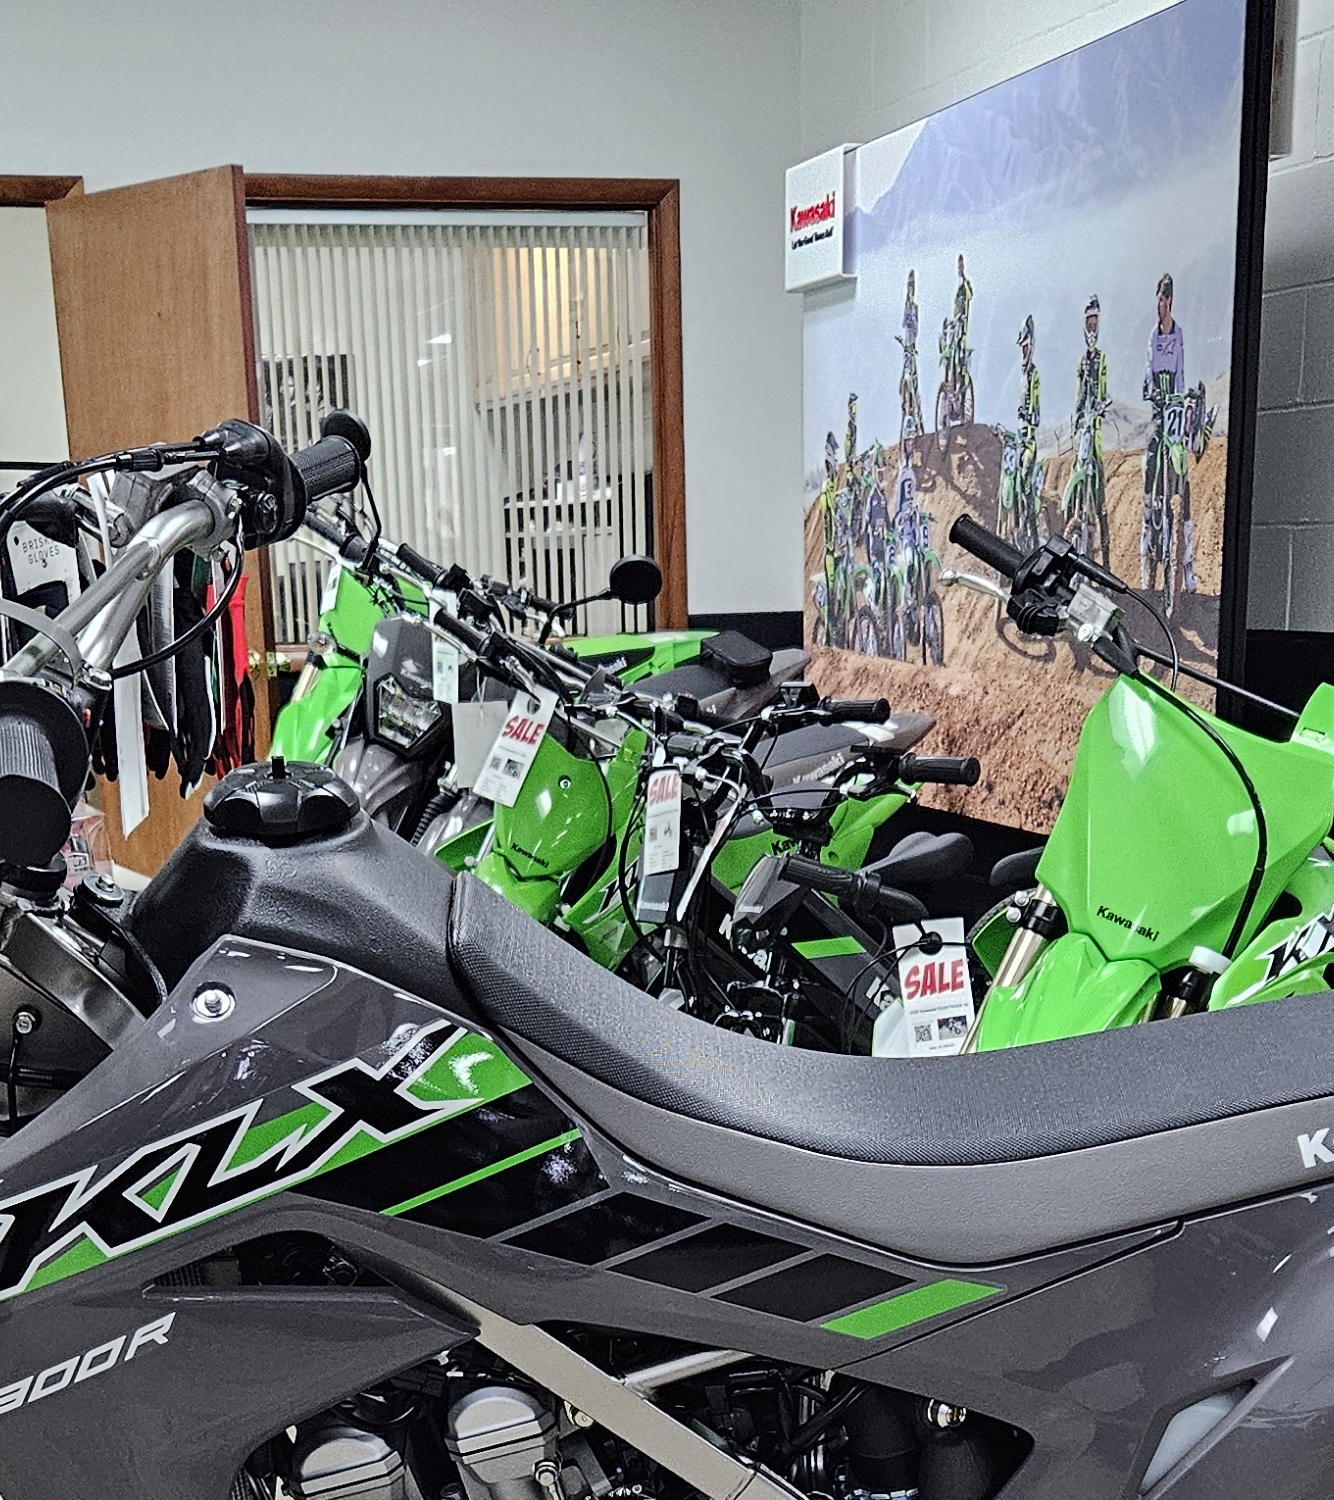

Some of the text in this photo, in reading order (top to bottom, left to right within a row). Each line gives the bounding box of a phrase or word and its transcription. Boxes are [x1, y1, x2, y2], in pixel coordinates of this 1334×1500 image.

[1167, 408, 1184, 437] 21
[501, 714, 545, 746] SALE
[648, 771, 680, 807] SALE
[511, 842, 550, 869] Kawasaki
[1096, 905, 1160, 942] Kawasaki
[903, 958, 965, 1001] SALE
